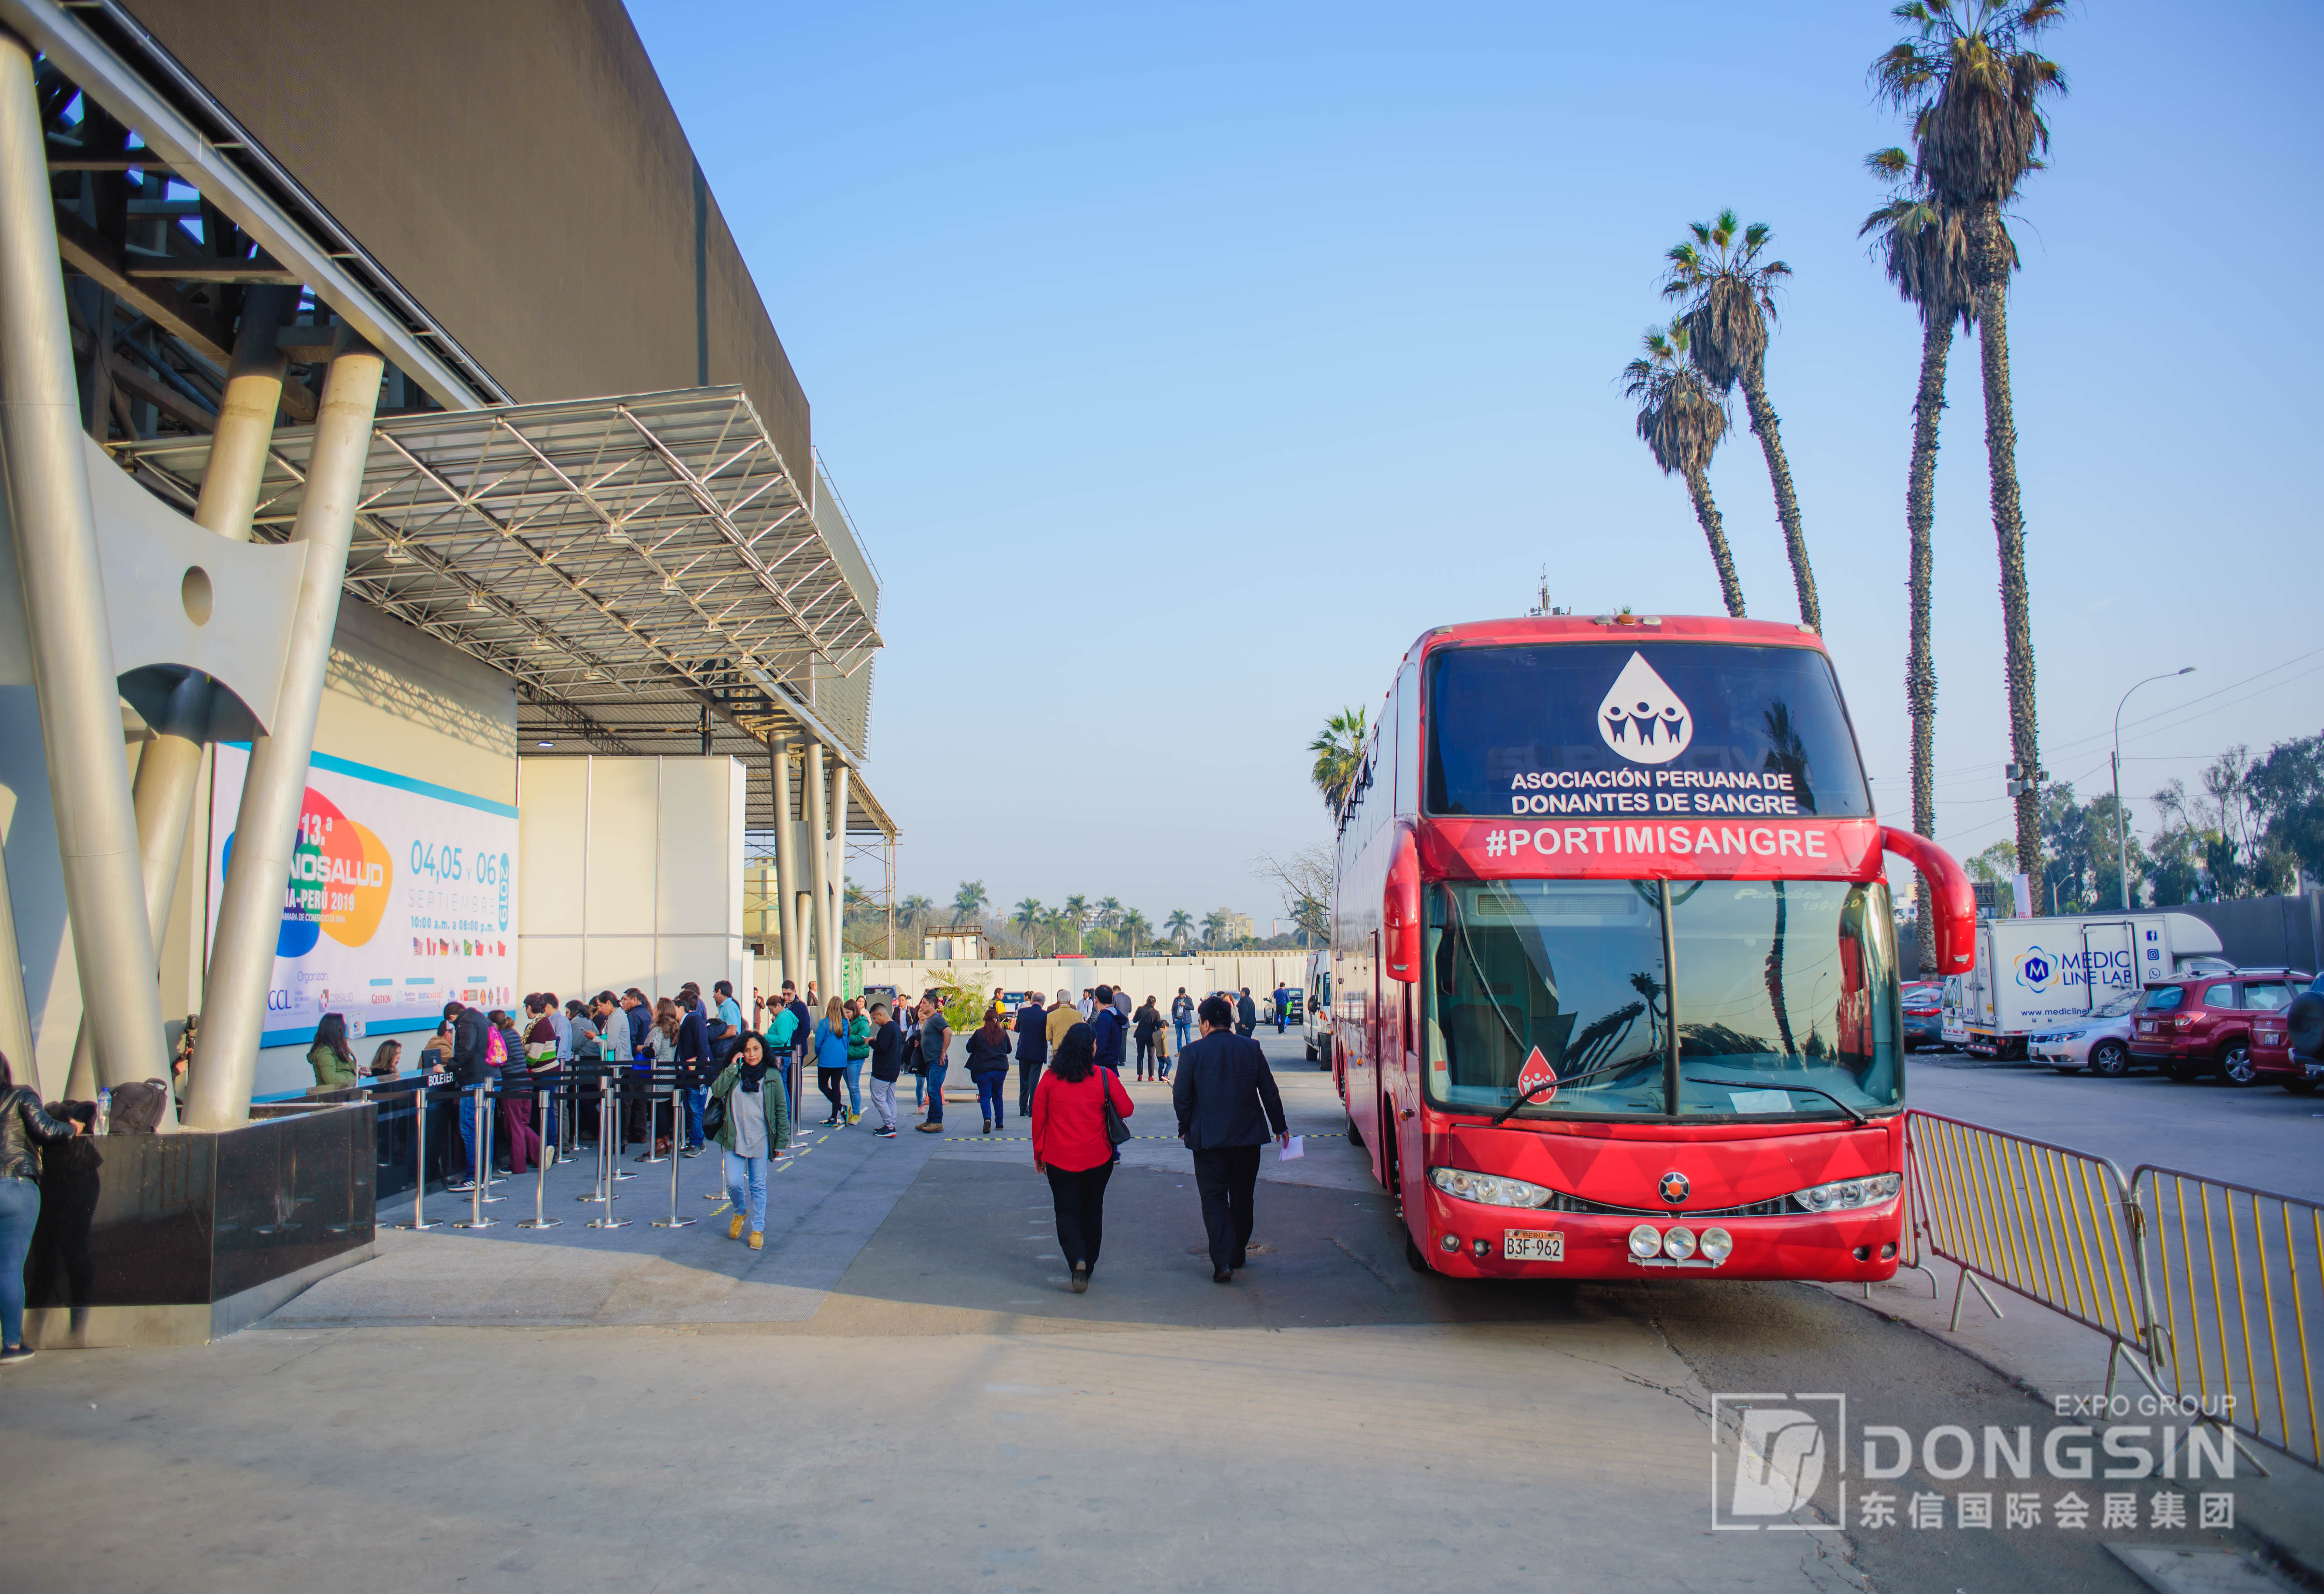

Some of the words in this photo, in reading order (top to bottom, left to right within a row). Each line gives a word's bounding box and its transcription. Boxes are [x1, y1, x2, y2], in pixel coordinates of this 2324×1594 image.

[1511, 767, 1650, 790] ASOCIACIÓN
[1655, 772, 1761, 790] PERUANA
[1763, 773, 1793, 791] DE
[1512, 793, 1649, 814] DONANTES
[1655, 793, 1690, 812] DE
[1694, 794, 1798, 814] SANGRE
[1485, 826, 1828, 858] #PORTIMISANGRE
[411, 839, 462, 885] 04,05
[467, 868, 472, 882] Y
[477, 852, 496, 885] 06
[331, 892, 355, 912] 2019
[408, 889, 495, 914] SEPTIEMBRE
[500, 865, 509, 923] 2019
[305, 914, 329, 922] COMERCIO
[411, 916, 432, 929] 10:00
[434, 920, 450, 930] a.m.
[453, 921, 456, 930] a
[459, 919, 478, 931] 08:00
[481, 923, 495, 934] p.m.
[2062, 950, 2130, 969] MEDIC
[2063, 971, 2097, 985] LINE
[2102, 970, 2131, 984] LAB
[268, 990, 292, 1011] CCL
[330, 993, 353, 1003] COMSALUD
[428, 1072, 455, 1086] BOLETER
[1507, 1238, 1560, 1257] B3F-962
